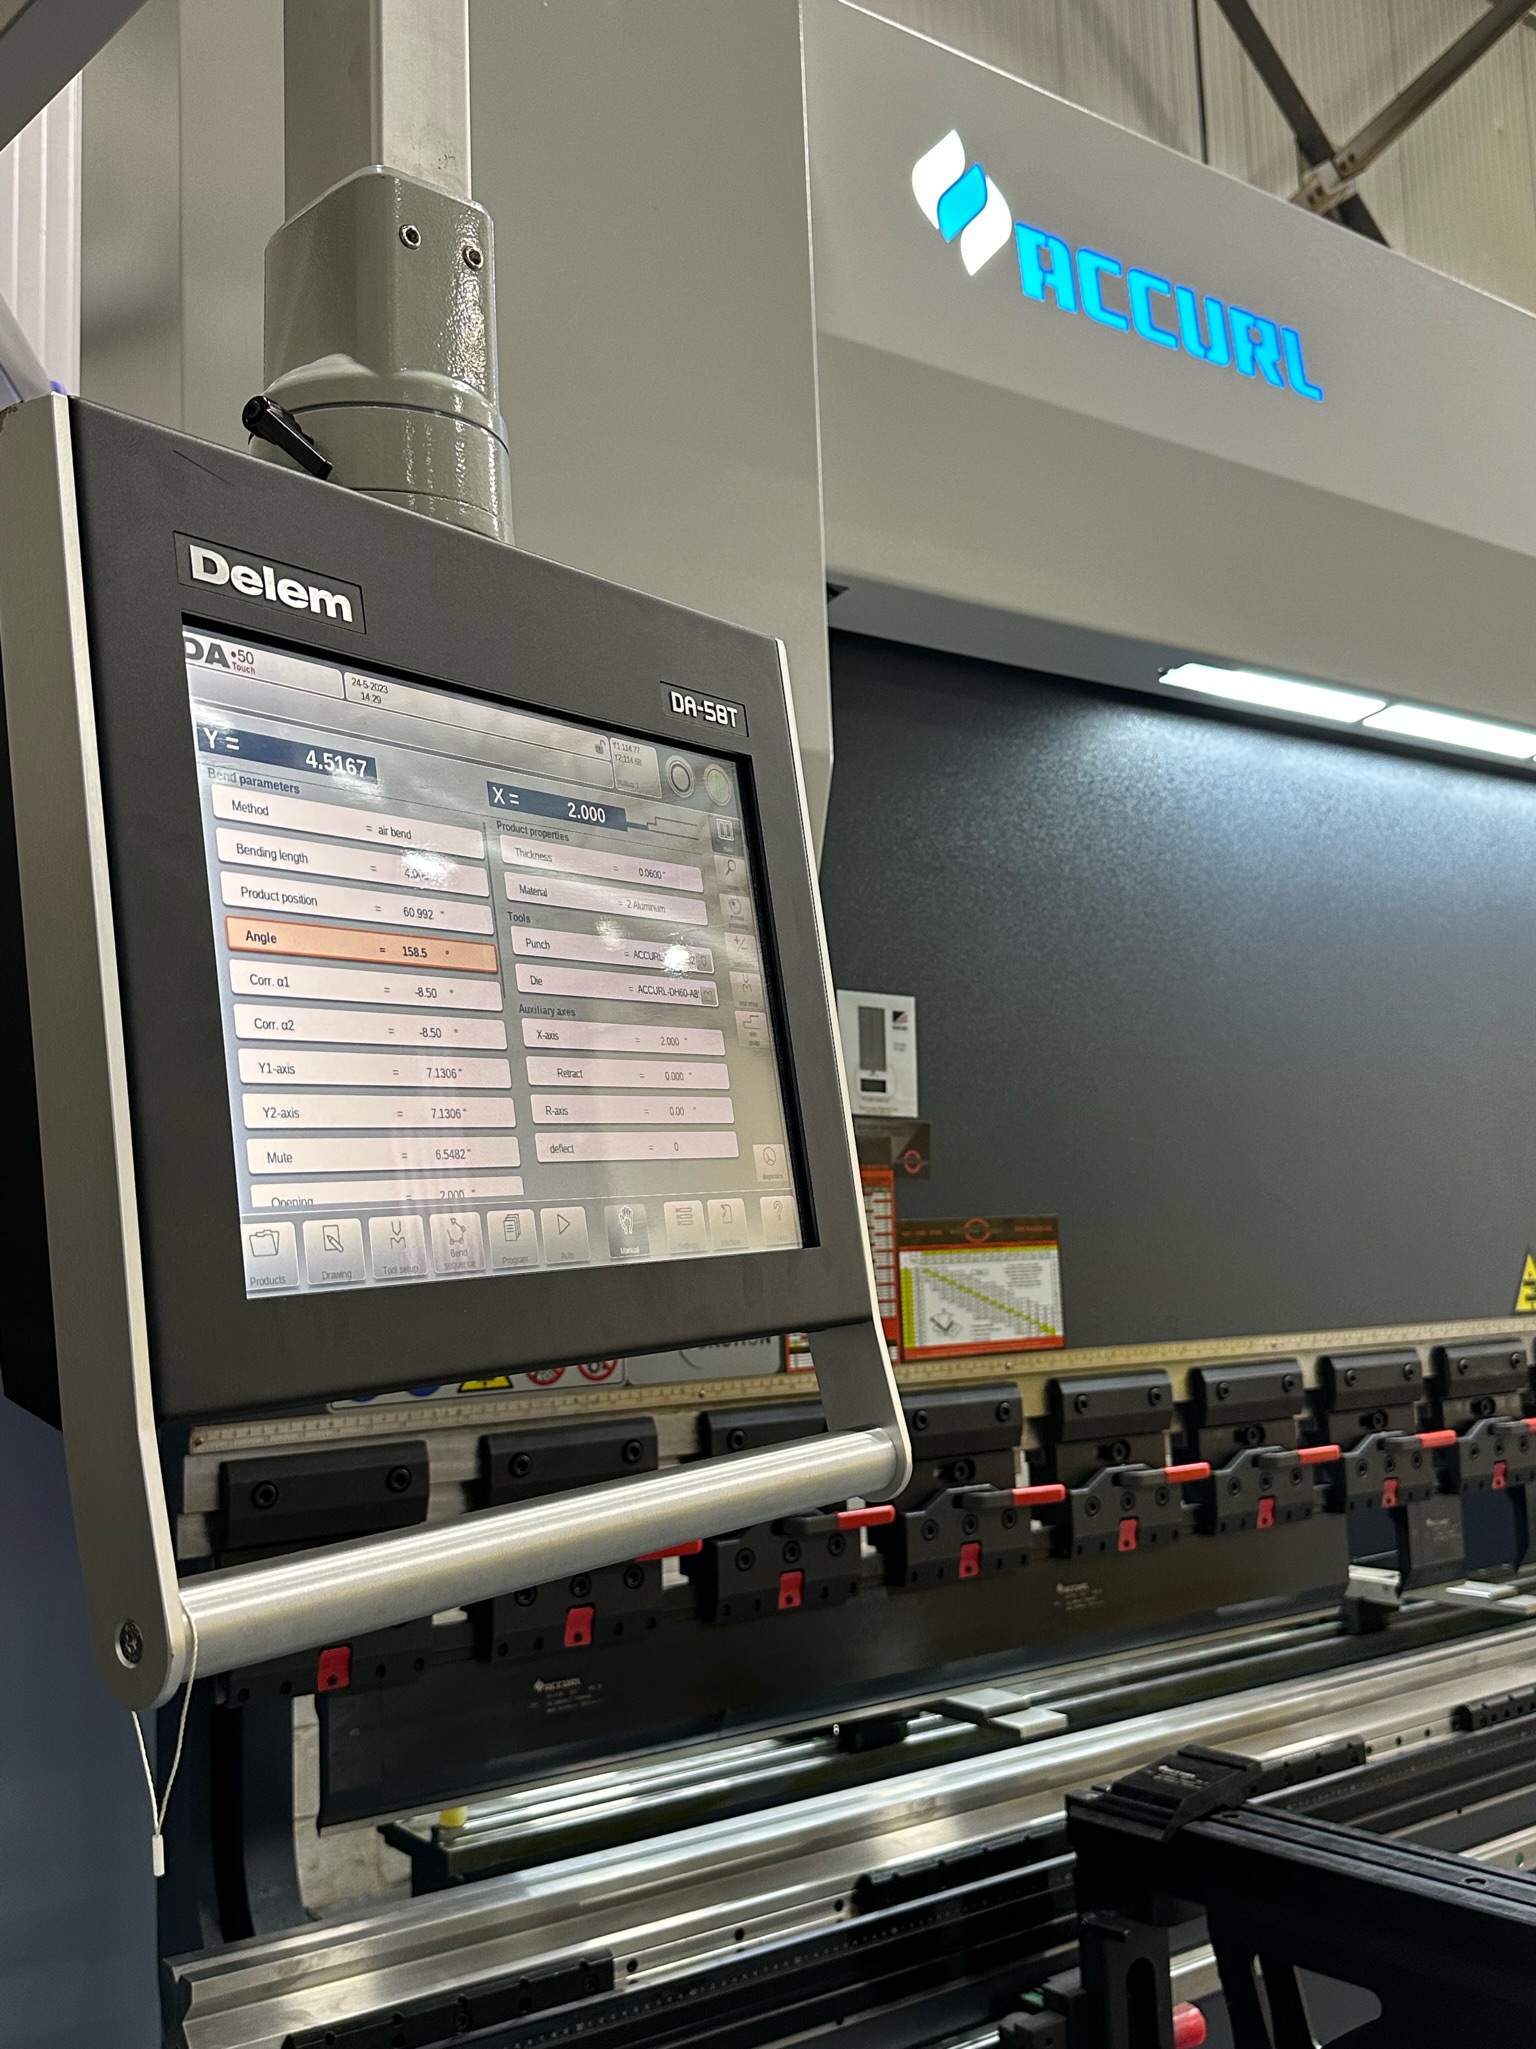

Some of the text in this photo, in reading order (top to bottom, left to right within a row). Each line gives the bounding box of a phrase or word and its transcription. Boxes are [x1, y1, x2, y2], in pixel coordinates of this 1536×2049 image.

[1015, 221, 1323, 402] ACCURL
[189, 544, 353, 623] Delem
[232, 662, 256, 675] Touch
[351, 677, 389, 694] 24-5-2023
[670, 690, 738, 728] DA-58T
[203, 727, 219, 749] Y
[305, 749, 367, 778] 4.5167
[207, 767, 300, 795] Bend parameters
[492, 786, 506, 805] X
[231, 799, 270, 817] Method
[566, 802, 606, 824] 2.000
[377, 826, 388, 837] air
[390, 826, 412, 840] bend
[496, 820, 570, 843] Product properties
[236, 842, 309, 865] Bending length
[514, 848, 553, 863] Thickness
[240, 886, 318, 907] Product position
[519, 883, 548, 897] Material
[626, 899, 632, 909] 2
[633, 900, 667, 913] Aluminum
[403, 907, 434, 920] 60.992
[507, 911, 531, 924] Tools
[245, 929, 278, 945] Angle
[525, 937, 551, 950] Punch
[402, 946, 428, 958] 158.5
[249, 973, 275, 987] Corr.
[530, 975, 543, 986] Die
[415, 987, 438, 999] -8.50
[518, 1003, 576, 1018] Auxiliary axes
[254, 1018, 279, 1031] Corr.
[419, 1027, 442, 1039] -8.50
[536, 1029, 559, 1041] X-axis
[660, 1036, 680, 1047] 2.000
[258, 1062, 296, 1075] Y1-axis
[557, 1067, 583, 1079] Retract
[665, 1071, 684, 1081] 0.000
[262, 1107, 300, 1119] Y2-axis
[545, 1105, 569, 1116] R-axis
[669, 1106, 684, 1117] 0.00
[550, 1143, 574, 1154] deflect
[673, 1141, 679, 1152] 0
[267, 1152, 293, 1164] Mute
[450, 1248, 468, 1258] Bend
[561, 1251, 575, 1260] Auto
[619, 1246, 640, 1255] Manual
[443, 1260, 477, 1270] sequence
[502, 1255, 529, 1266] Program
[321, 1269, 352, 1282] Drawing
[382, 1264, 419, 1276] Tool setup
[250, 1273, 287, 1287] Products
